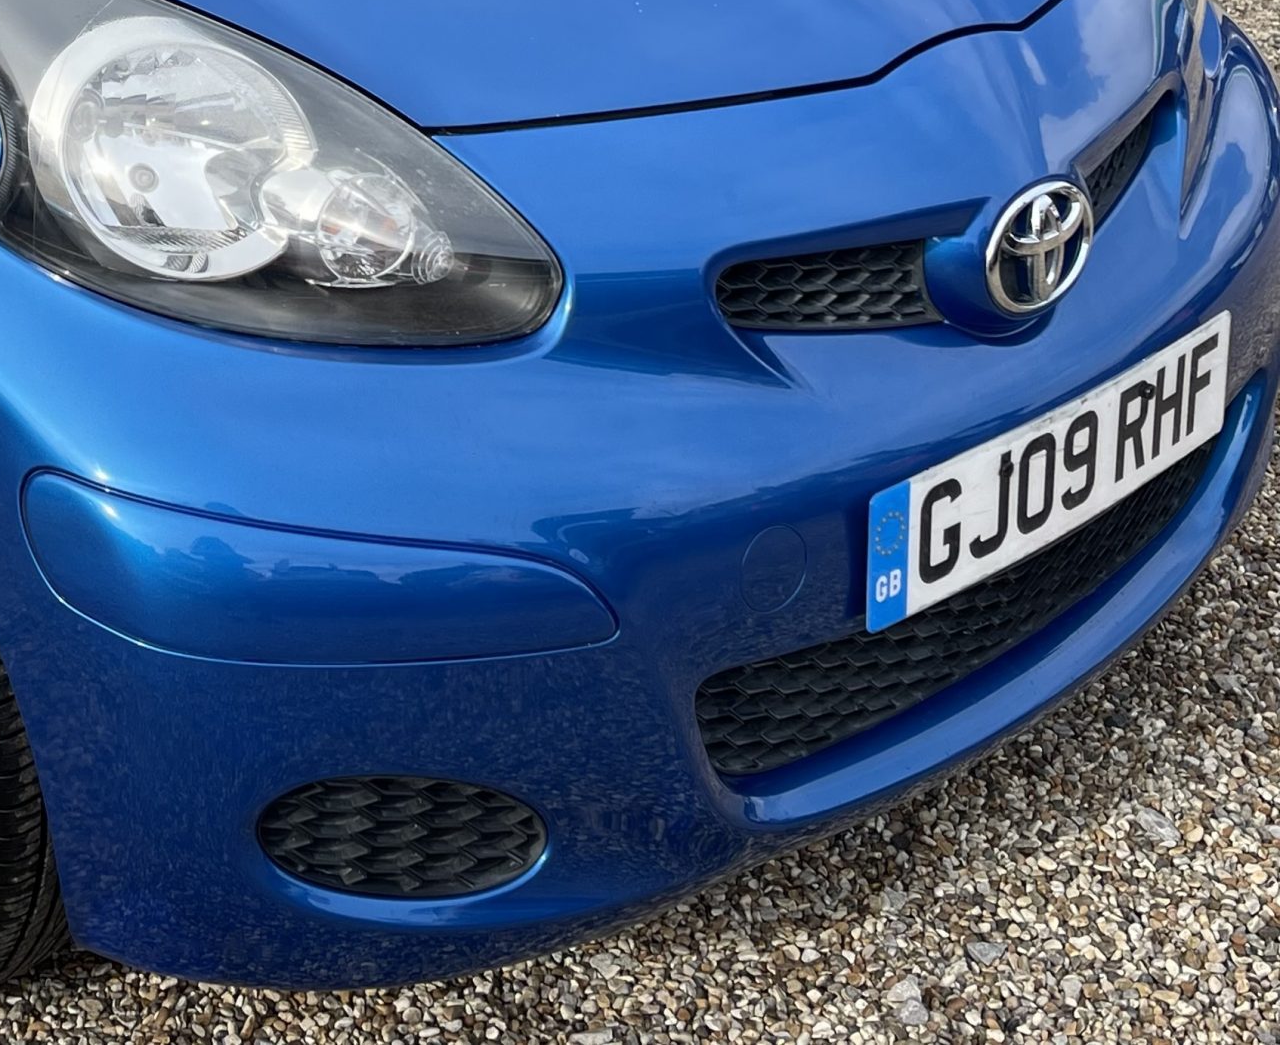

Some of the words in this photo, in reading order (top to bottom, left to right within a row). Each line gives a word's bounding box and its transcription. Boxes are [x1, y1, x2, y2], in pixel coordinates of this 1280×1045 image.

[919, 410, 1098, 584] GJ09
[1114, 332, 1220, 483] RHF
[875, 568, 902, 603] GB
